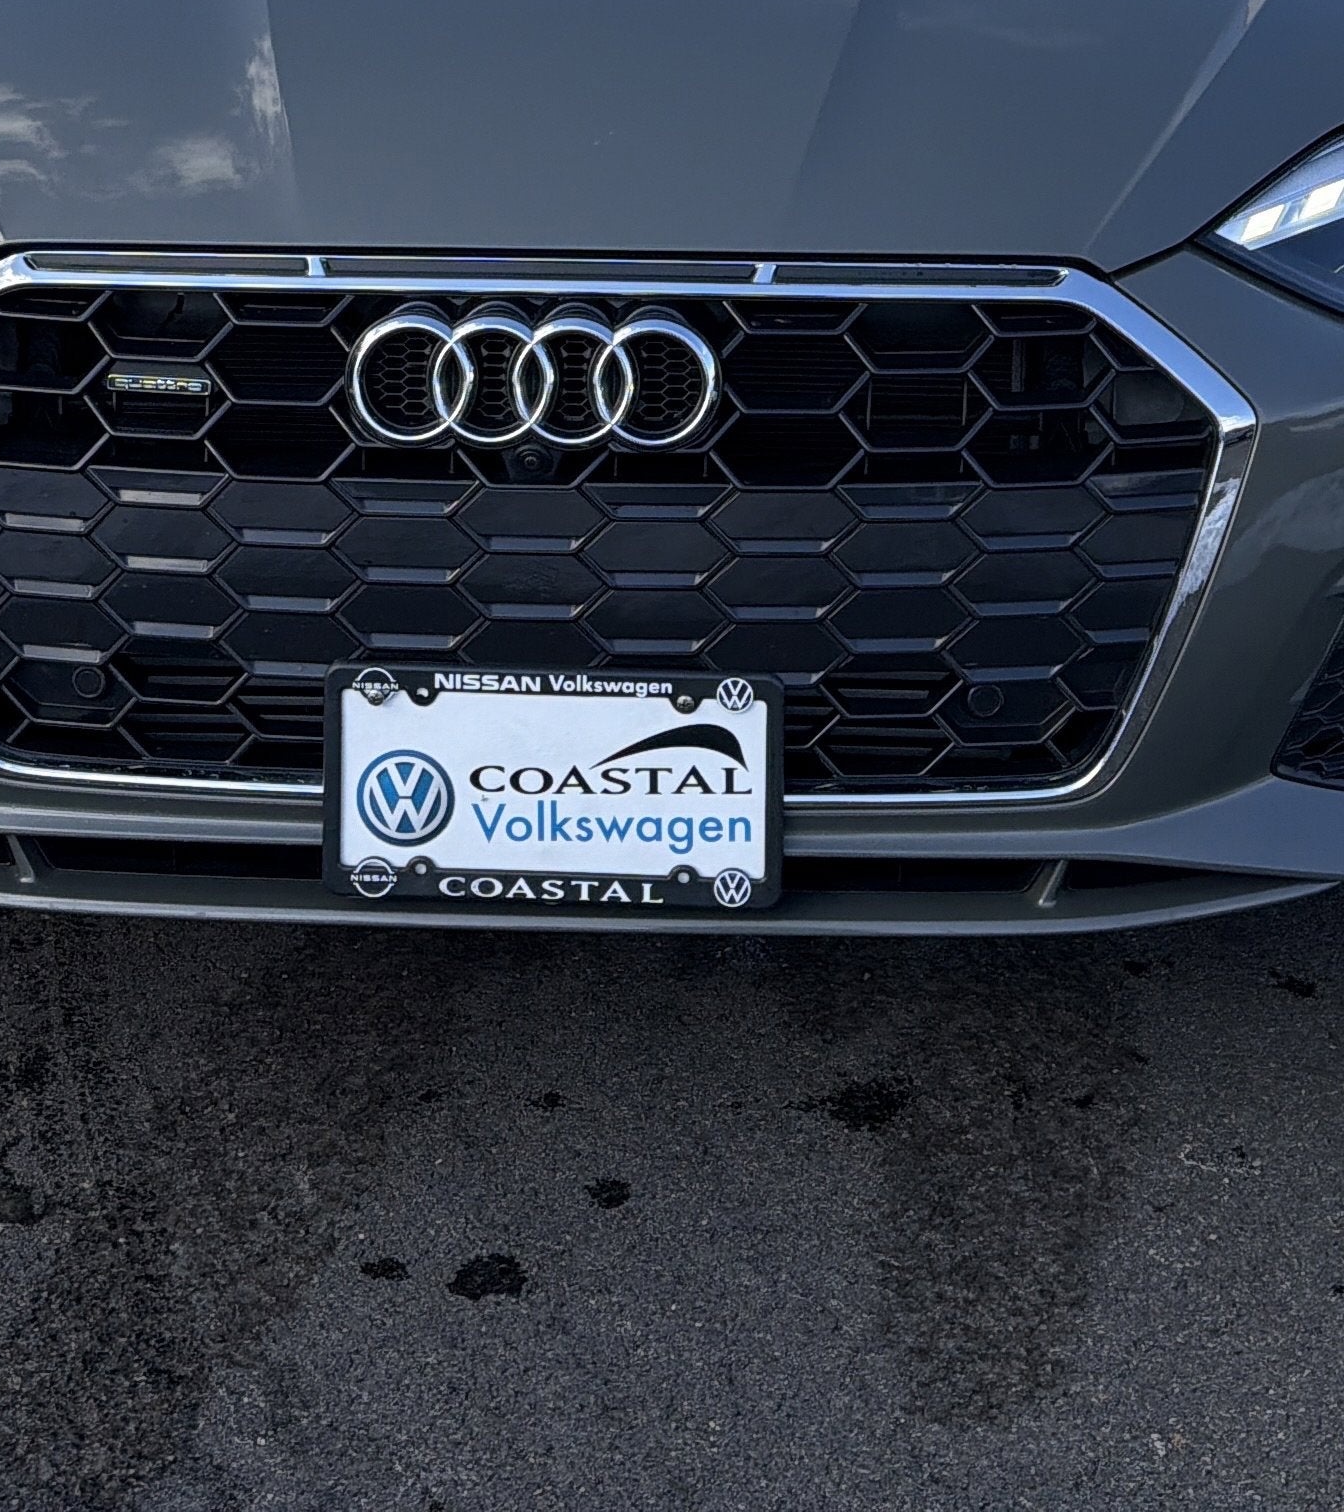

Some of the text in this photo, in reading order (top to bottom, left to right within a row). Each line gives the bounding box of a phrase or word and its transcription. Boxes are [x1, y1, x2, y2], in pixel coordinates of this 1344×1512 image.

[434, 673, 673, 697] NISSAN Volkswagen
[469, 764, 753, 795] COASTAL
[471, 799, 752, 855] Volkswagen
[350, 874, 398, 883] NISSAN
[438, 876, 664, 905] COASTAL
